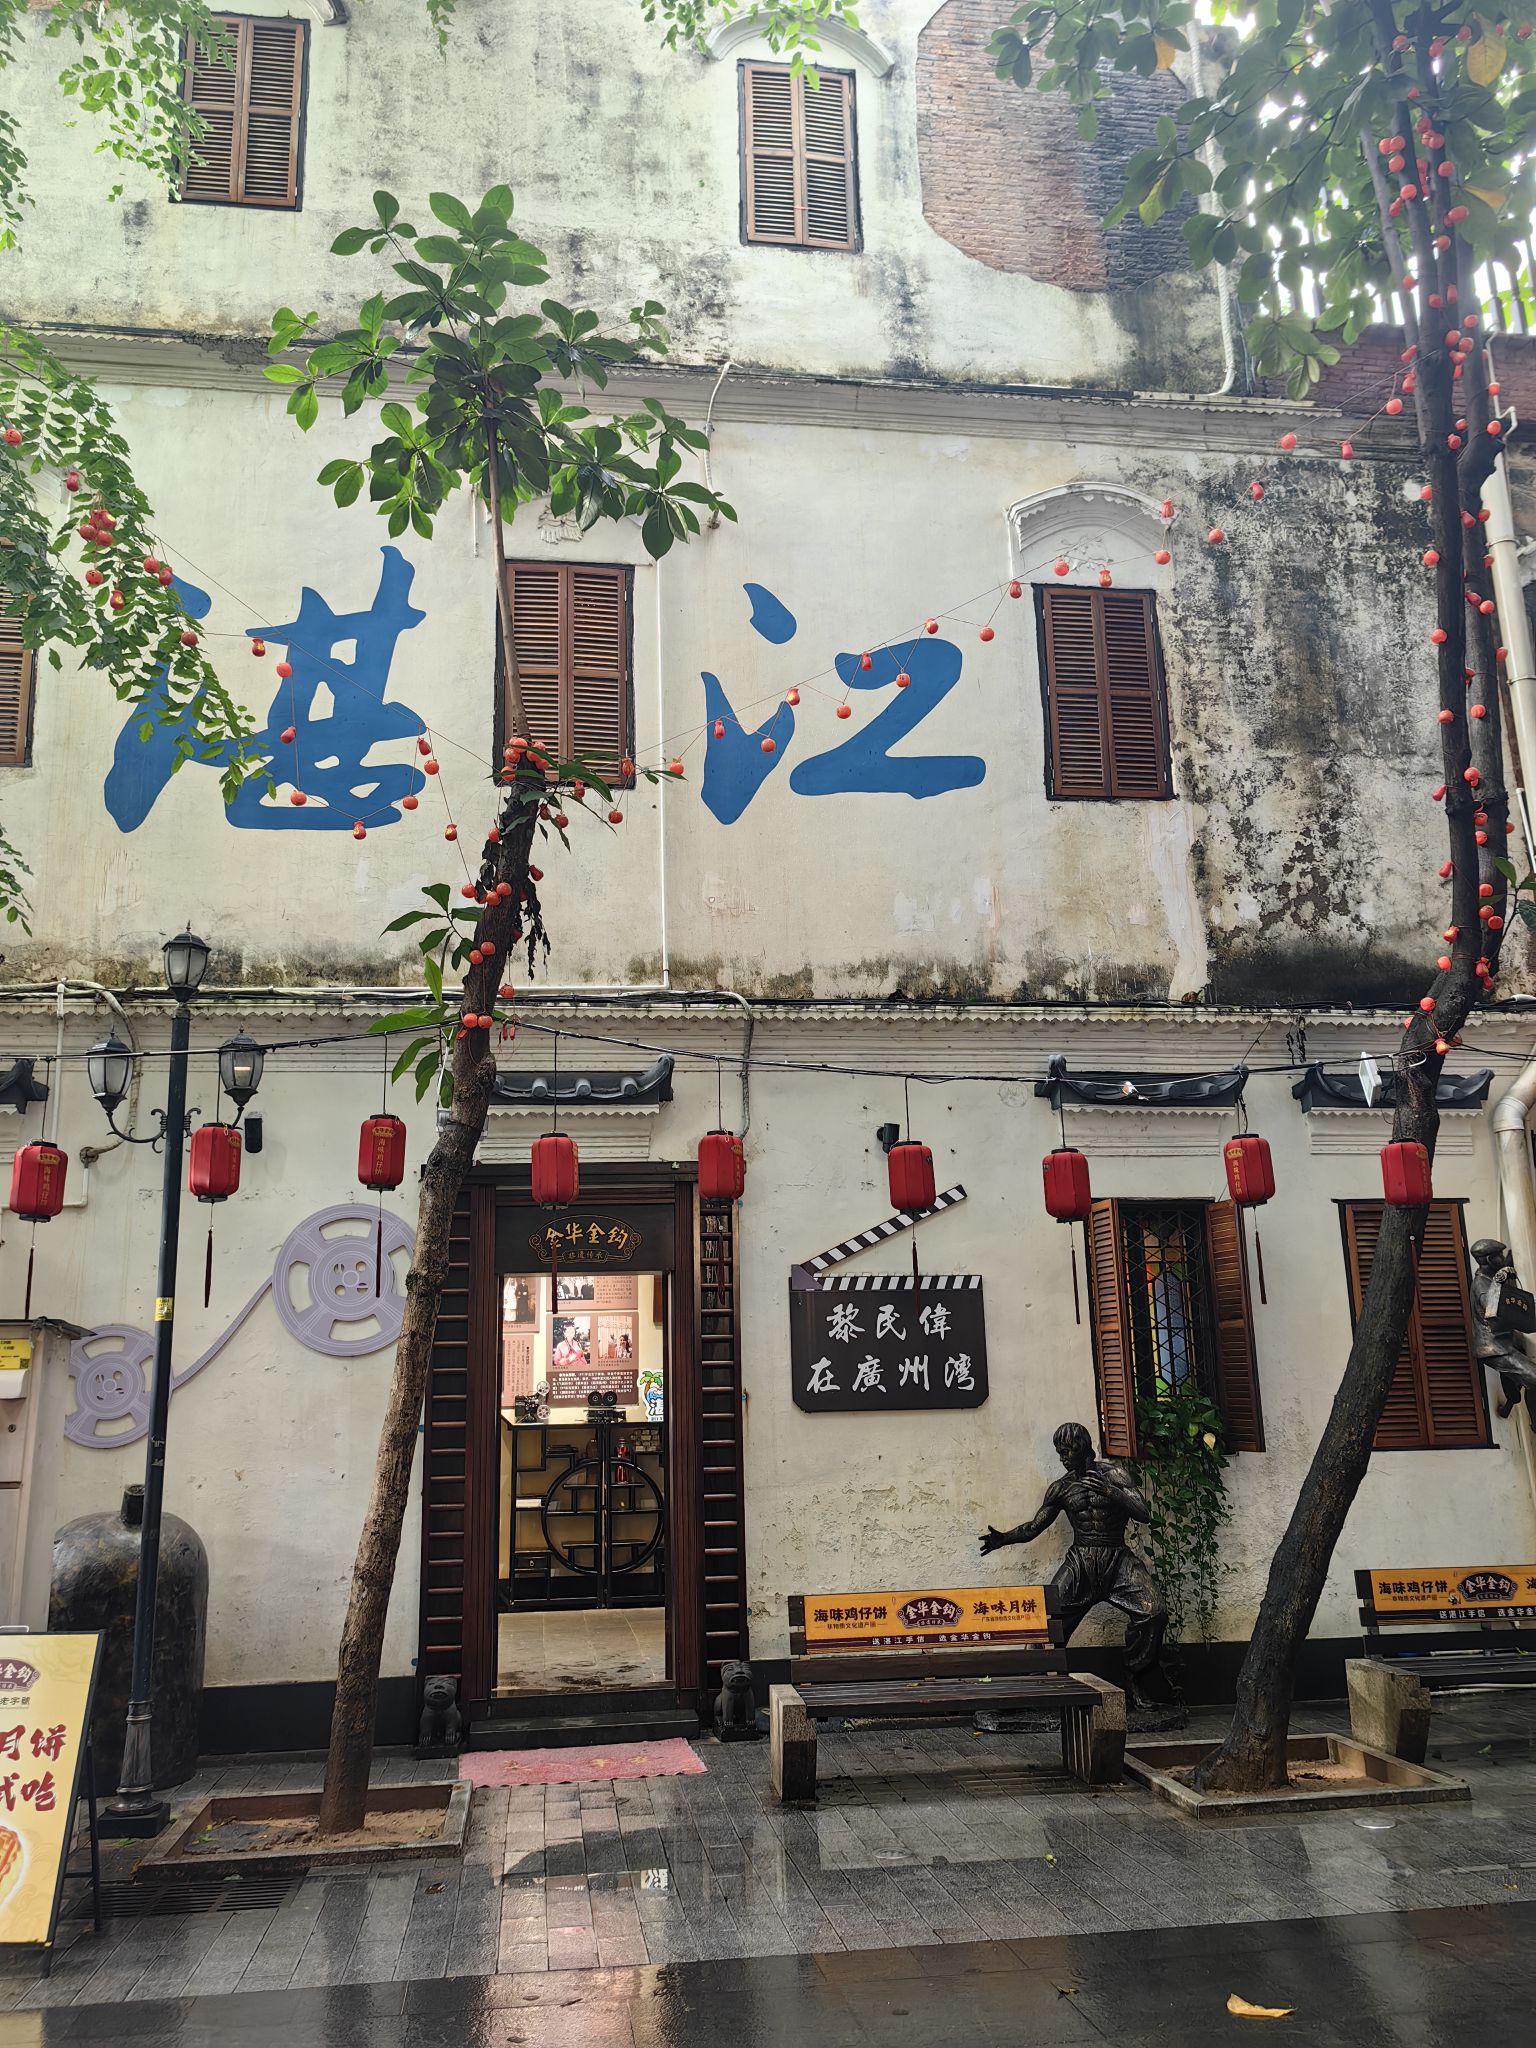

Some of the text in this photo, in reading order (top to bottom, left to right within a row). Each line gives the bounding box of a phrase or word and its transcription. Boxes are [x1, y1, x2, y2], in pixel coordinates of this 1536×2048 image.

[104, 546, 986, 833] 湛江
[545, 1222, 629, 1250] 金华金钩
[826, 1302, 952, 1343] 黎民偉
[1378, 1580, 1448, 1595] 海味鸡仔饼
[1465, 1575, 1511, 1593] 金华金钩
[813, 1606, 888, 1622] 海味鸡仔饼
[906, 1601, 956, 1620] 金华金钩
[973, 1599, 1037, 1616] 海味月饼
